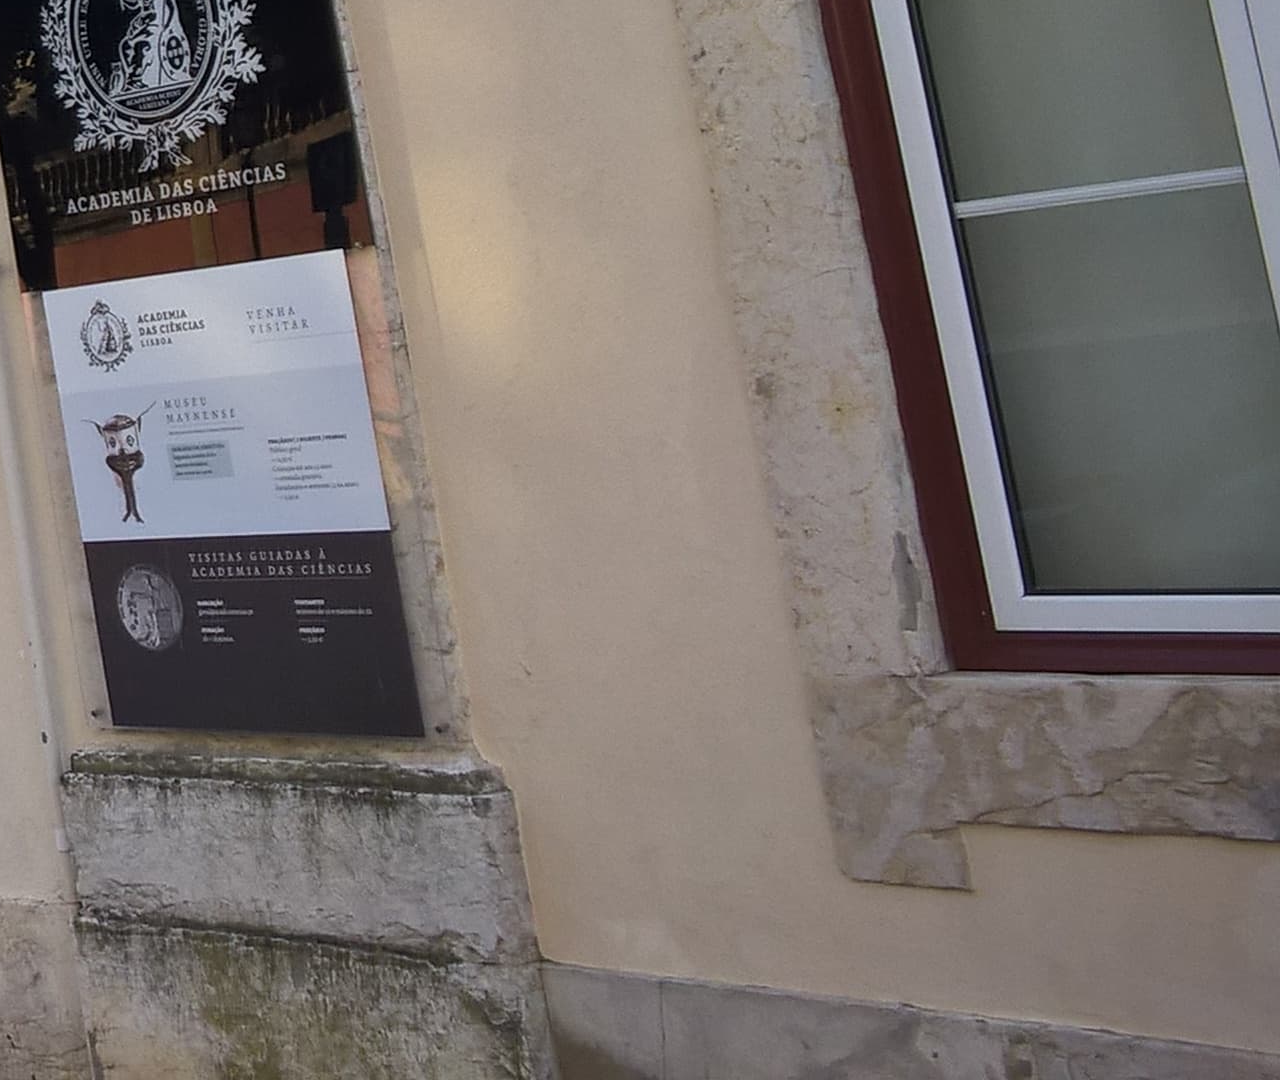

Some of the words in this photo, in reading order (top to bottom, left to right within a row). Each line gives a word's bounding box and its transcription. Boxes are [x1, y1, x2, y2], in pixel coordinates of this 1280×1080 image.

[66, 186, 155, 215] ACADEMIA
[159, 179, 194, 200] DAS
[199, 162, 287, 193] CIÊNCIAS
[130, 208, 153, 225] DE
[157, 198, 218, 221] LISBOA
[137, 309, 188, 324] ACADEMIA
[245, 306, 296, 320] VENHA
[139, 325, 158, 337] DAS
[159, 319, 205, 334] CIÊNCIAS
[249, 318, 309, 335] VISITAR
[140, 337, 173, 348] LISBOA
[164, 396, 207, 409] MUSEU
[188, 551, 242, 564] VISITAS
[249, 550, 311, 562] GUIADAS
[319, 547, 327, 561] À
[192, 566, 261, 578] ACADEMIA
[268, 565, 294, 577] DAS
[301, 562, 372, 576] CIÊNCIAS
